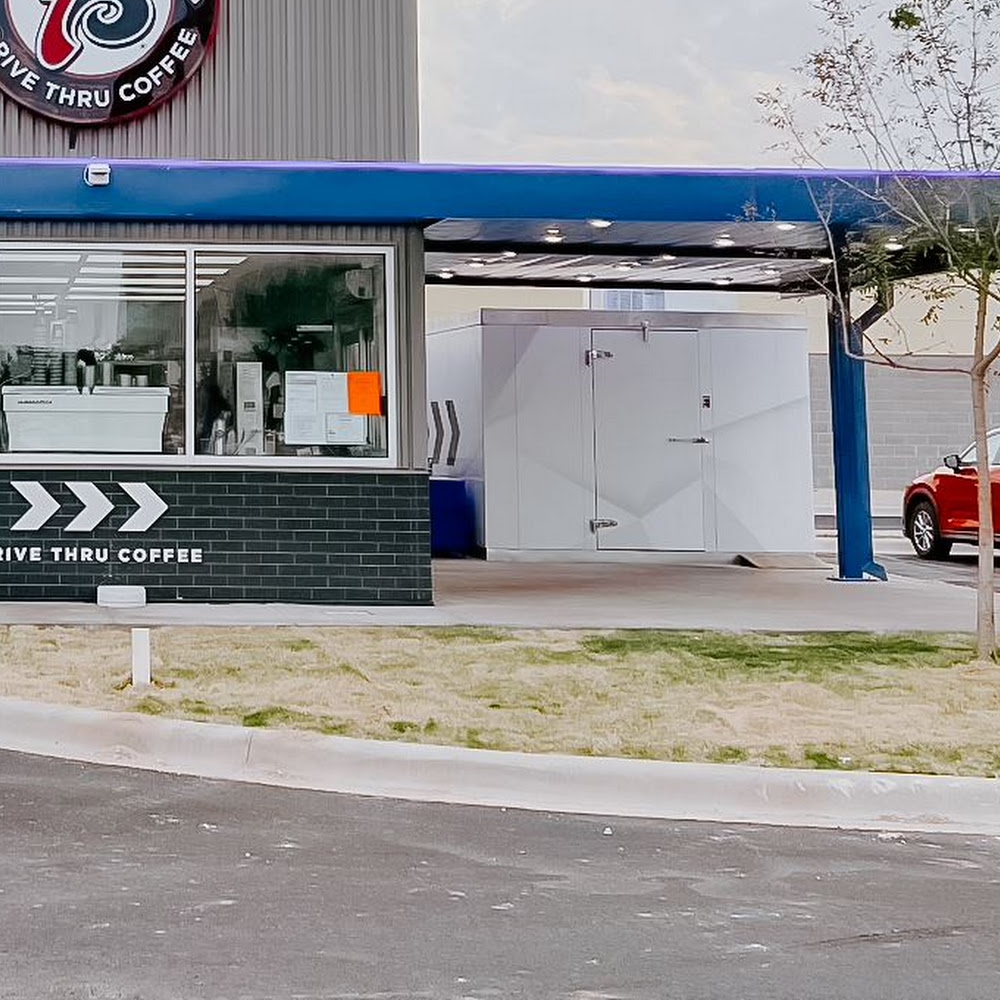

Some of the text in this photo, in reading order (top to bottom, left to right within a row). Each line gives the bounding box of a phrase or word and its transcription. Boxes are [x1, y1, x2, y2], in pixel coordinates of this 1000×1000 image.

[45, 81, 110, 108] THRU
[118, 27, 198, 102] COFFEE
[50, 547, 109, 563] THRU
[117, 548, 203, 563] COFFEE
